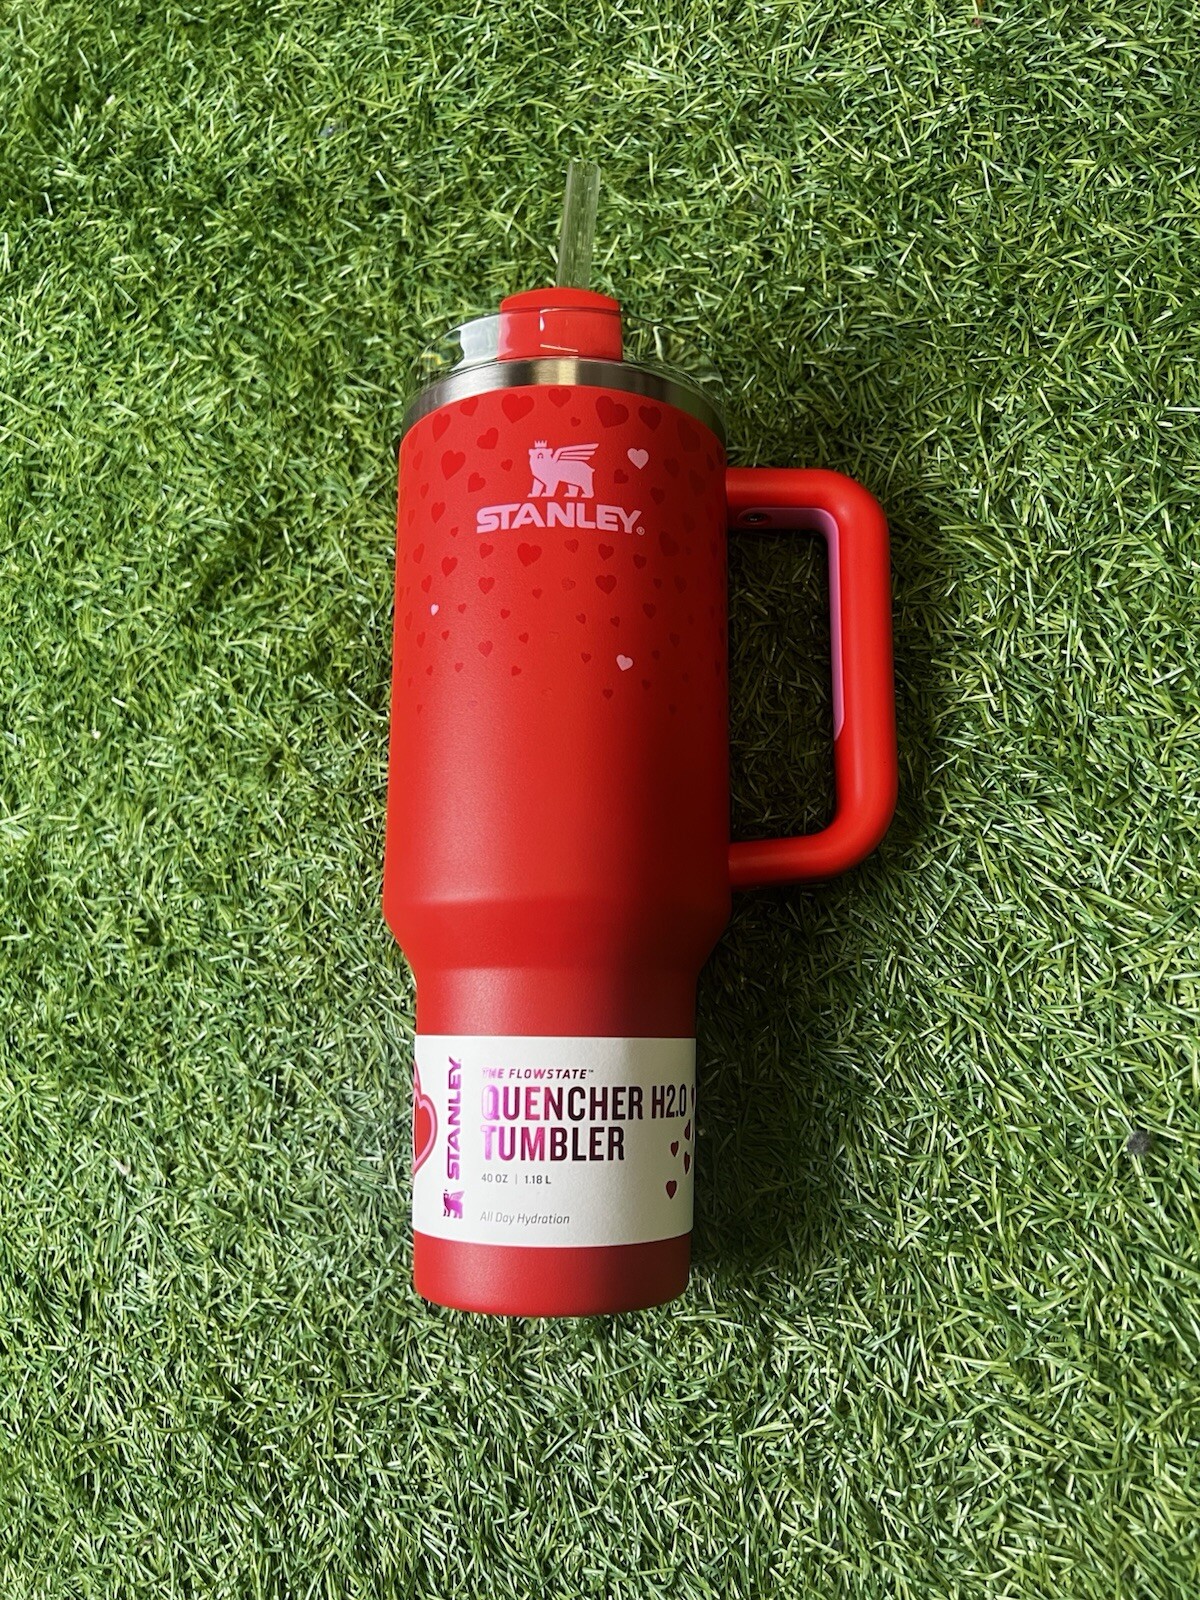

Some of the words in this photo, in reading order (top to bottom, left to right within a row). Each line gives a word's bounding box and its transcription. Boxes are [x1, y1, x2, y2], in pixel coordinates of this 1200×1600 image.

[482, 1067, 504, 1079] THE
[481, 1084, 643, 1121] QUENCHER
[651, 1083, 686, 1119] H2.0
[480, 1125, 625, 1161] TUMBLER
[481, 1173, 493, 1183] 40
[495, 1173, 508, 1184] OZ
[524, 1174, 543, 1185] 1.18
[545, 1174, 552, 1185] L
[480, 1211, 493, 1223] All
[495, 1211, 515, 1226] Day
[517, 1213, 570, 1226] Hydration
